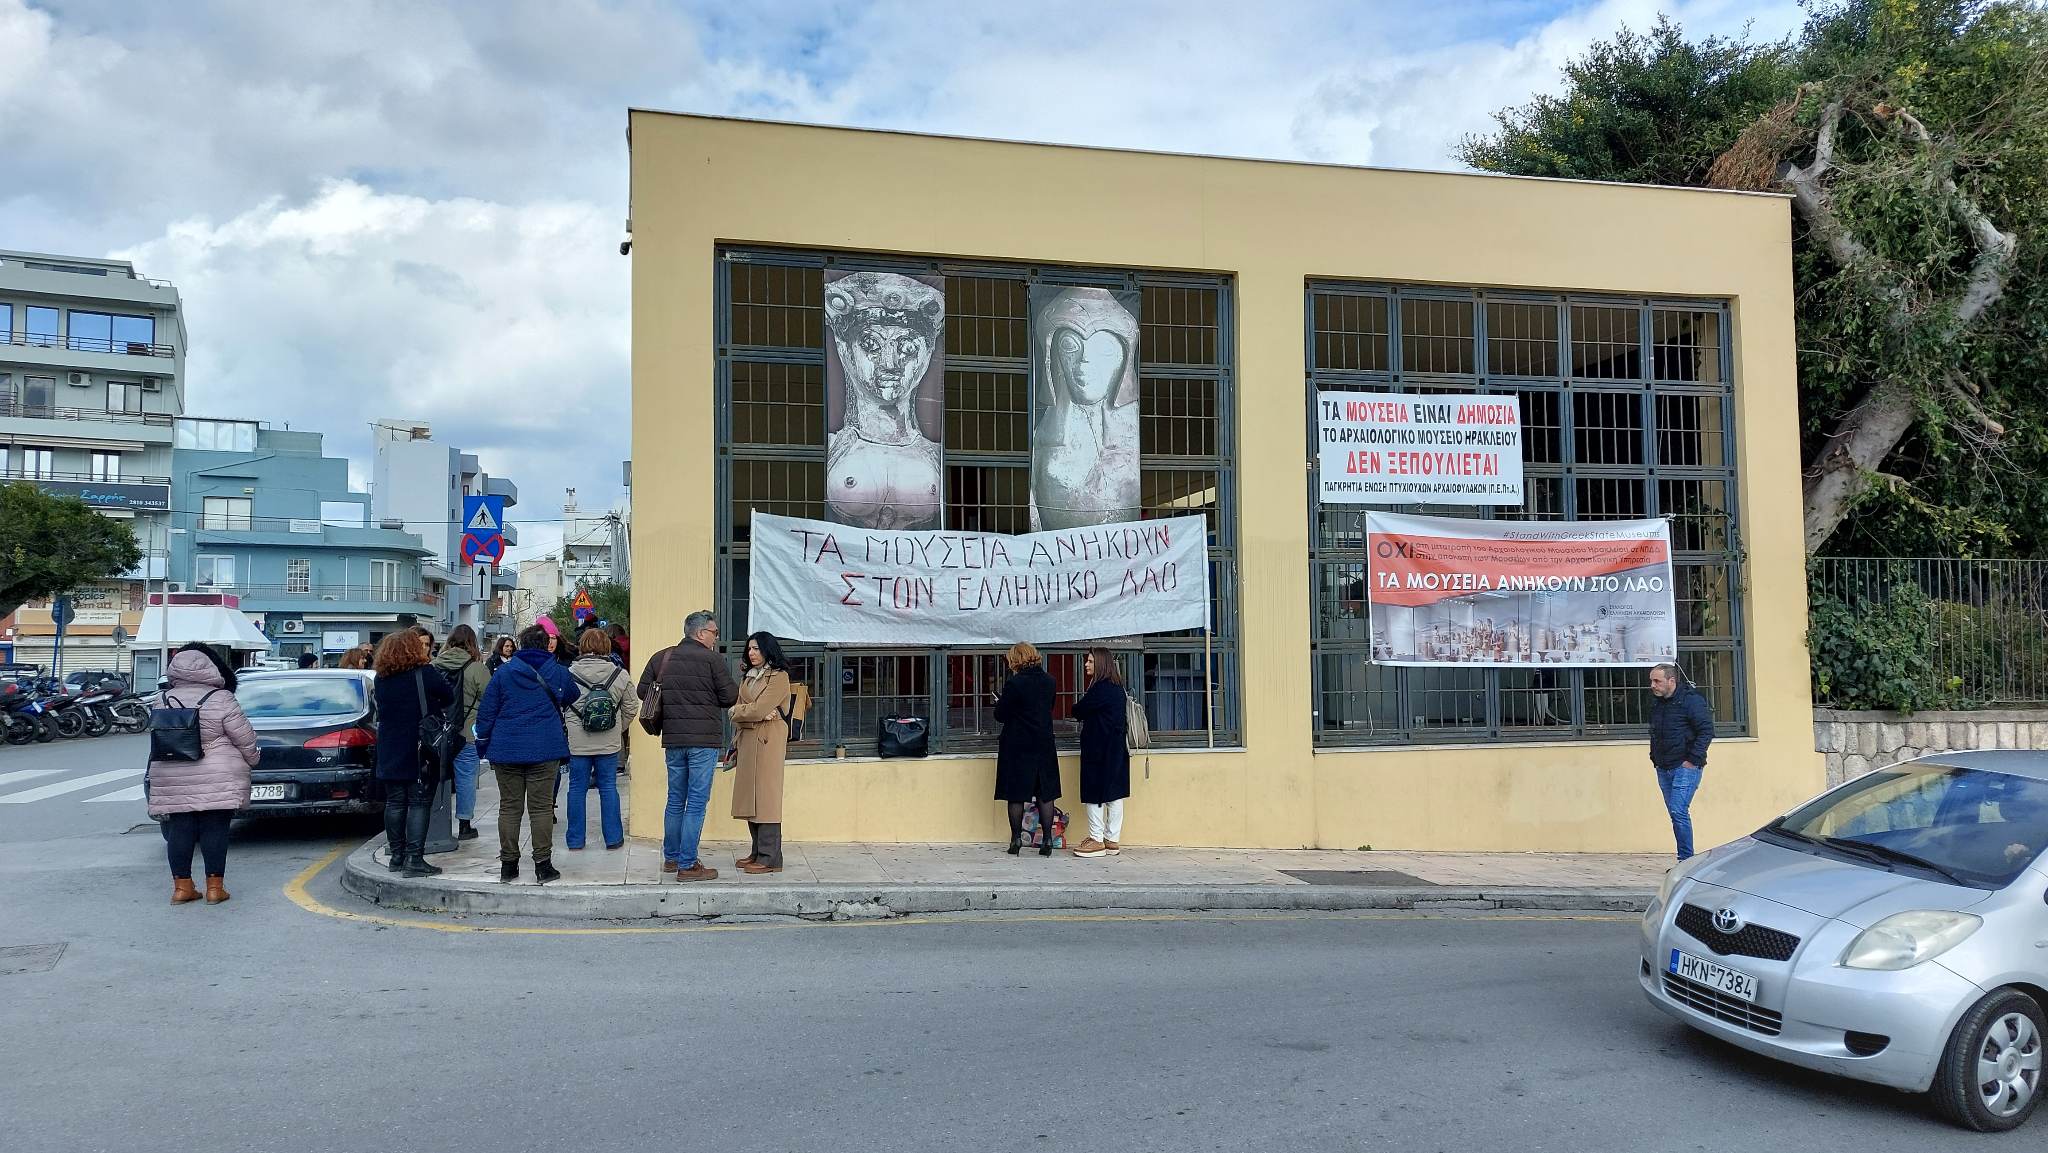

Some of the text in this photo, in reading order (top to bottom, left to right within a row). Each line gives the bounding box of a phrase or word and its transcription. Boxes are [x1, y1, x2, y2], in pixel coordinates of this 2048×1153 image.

[1322, 401, 1516, 425] ΤΑ ΜΟΥΣΕΙΑ ΕΙΝΑΙ ΔΗΜΟΣΙΑ
[1322, 428, 1517, 446] ΤΟ ΑΡΧΑΙΟΛΟΓΙΚΟ ΜΟΥΣΕΙΟ ΗΡΑΚΛΕΙΟΥ
[1346, 451, 1498, 476] ΔΕΝ ΞΕΠΟΥΛΙΕΤΑΙ
[1324, 481, 1363, 492] ΠΑΓΚΡΗΤΙΑ
[1364, 482, 1387, 493] ΕΝΩΣΗ
[1389, 482, 1431, 493] ΠΤΥΧΙΟΥΧΩΝ
[1433, 483, 1487, 494] ΑΡΧΑΙΟΦΥΛΑΚΩΝ
[790, 524, 1170, 569] ΤΑ ΜΟΥΣΕΙΑ ΑΝΗΚΟΥΝ
[1377, 541, 1414, 559] ΟΧΙ
[840, 561, 1177, 611] ΣΤΟΝ ΕΛΛΗΝΙΚΟ ΛΑΟ
[1377, 572, 1664, 593] ΤΑ ΜΟΥΣΕΙΑ ΑΝΗΚΟΥΝ ΣΤΟ ΛΑΟ
